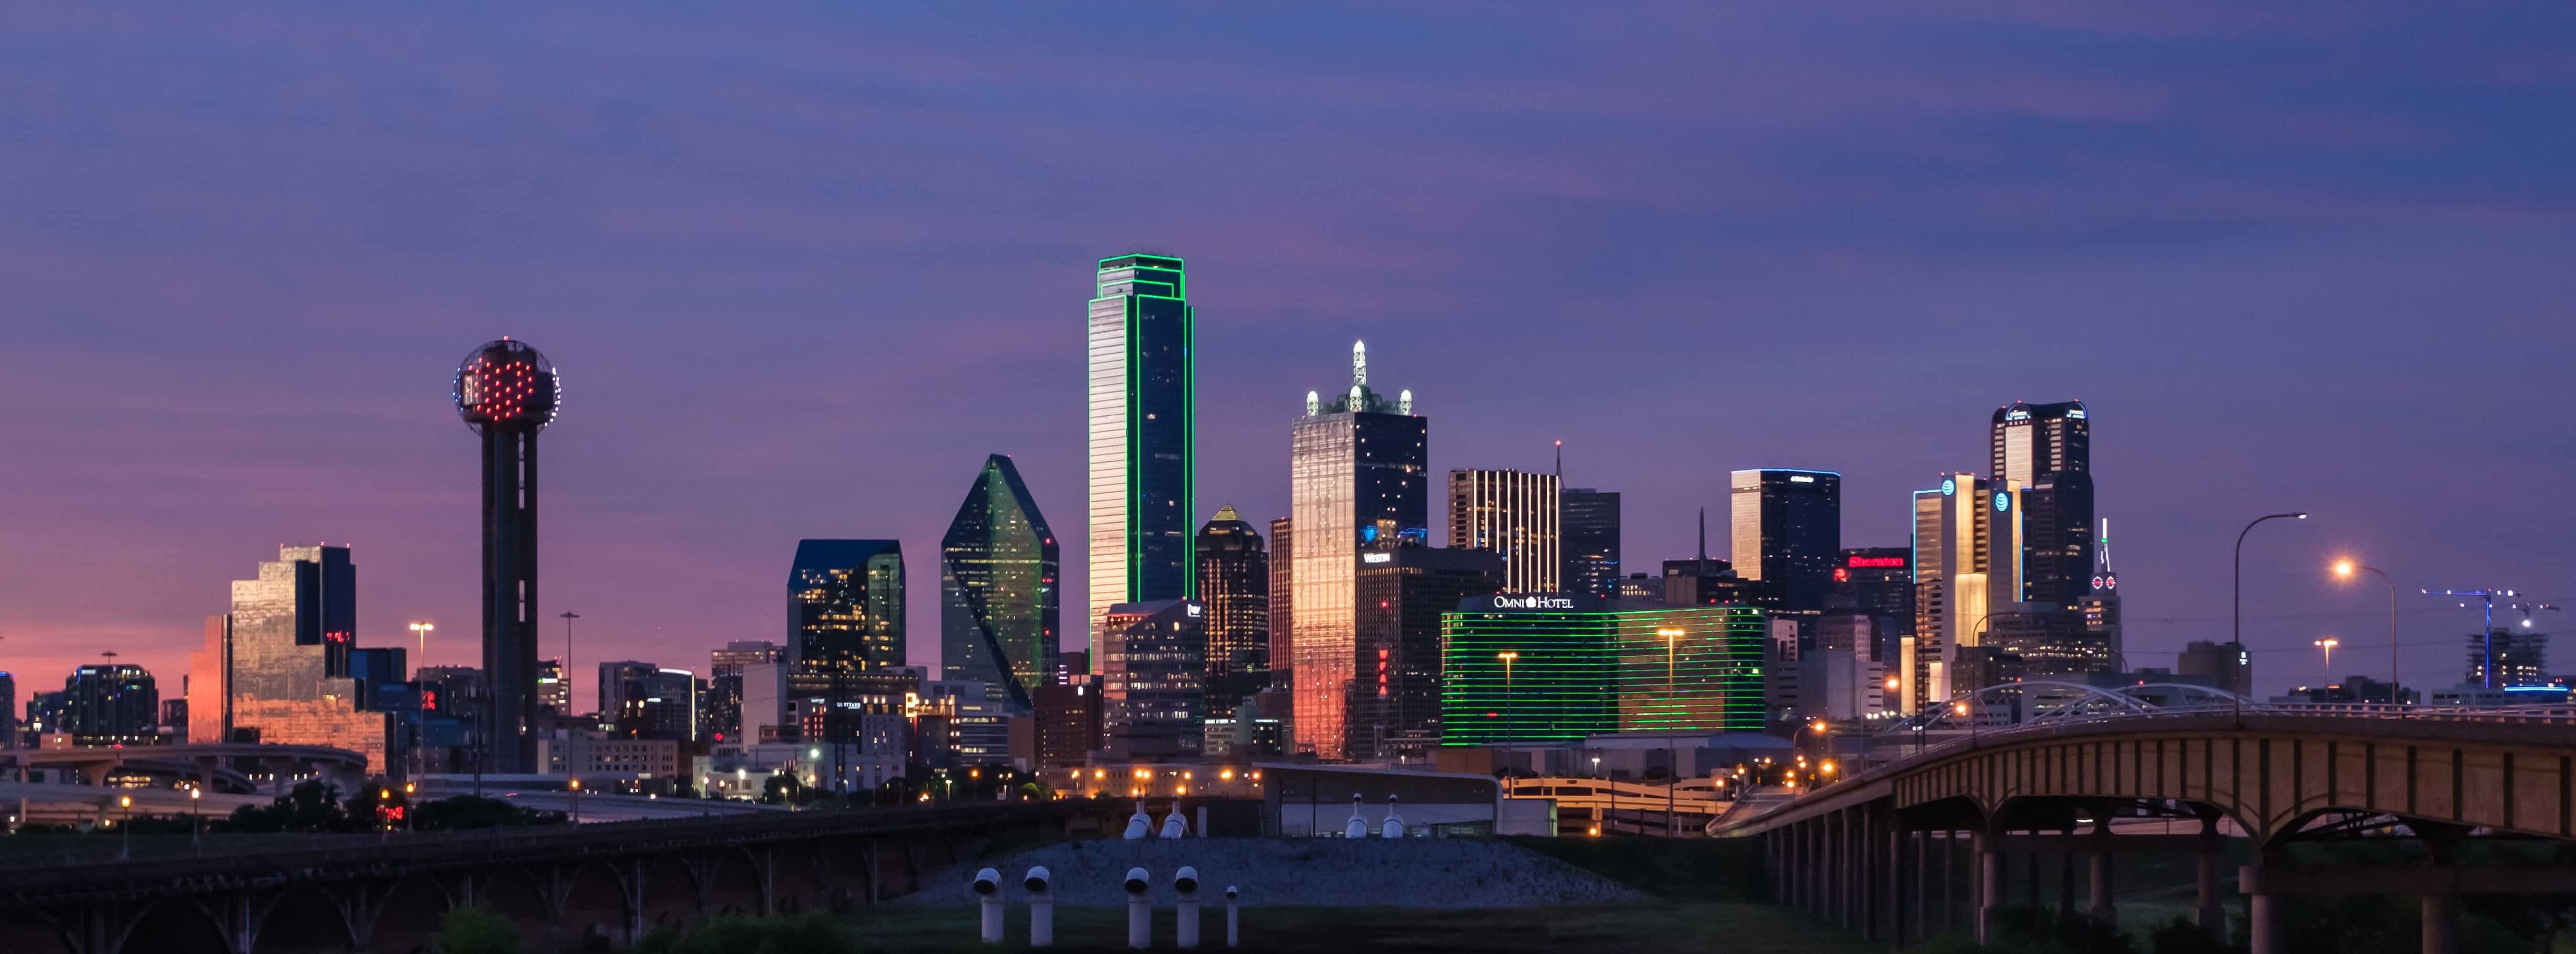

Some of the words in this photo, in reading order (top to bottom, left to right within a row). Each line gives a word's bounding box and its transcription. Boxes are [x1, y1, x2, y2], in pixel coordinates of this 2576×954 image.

[1848, 556, 1904, 568] Sheraton
[1494, 595, 1525, 609] OMNI
[1537, 596, 1574, 609] HOTEL
